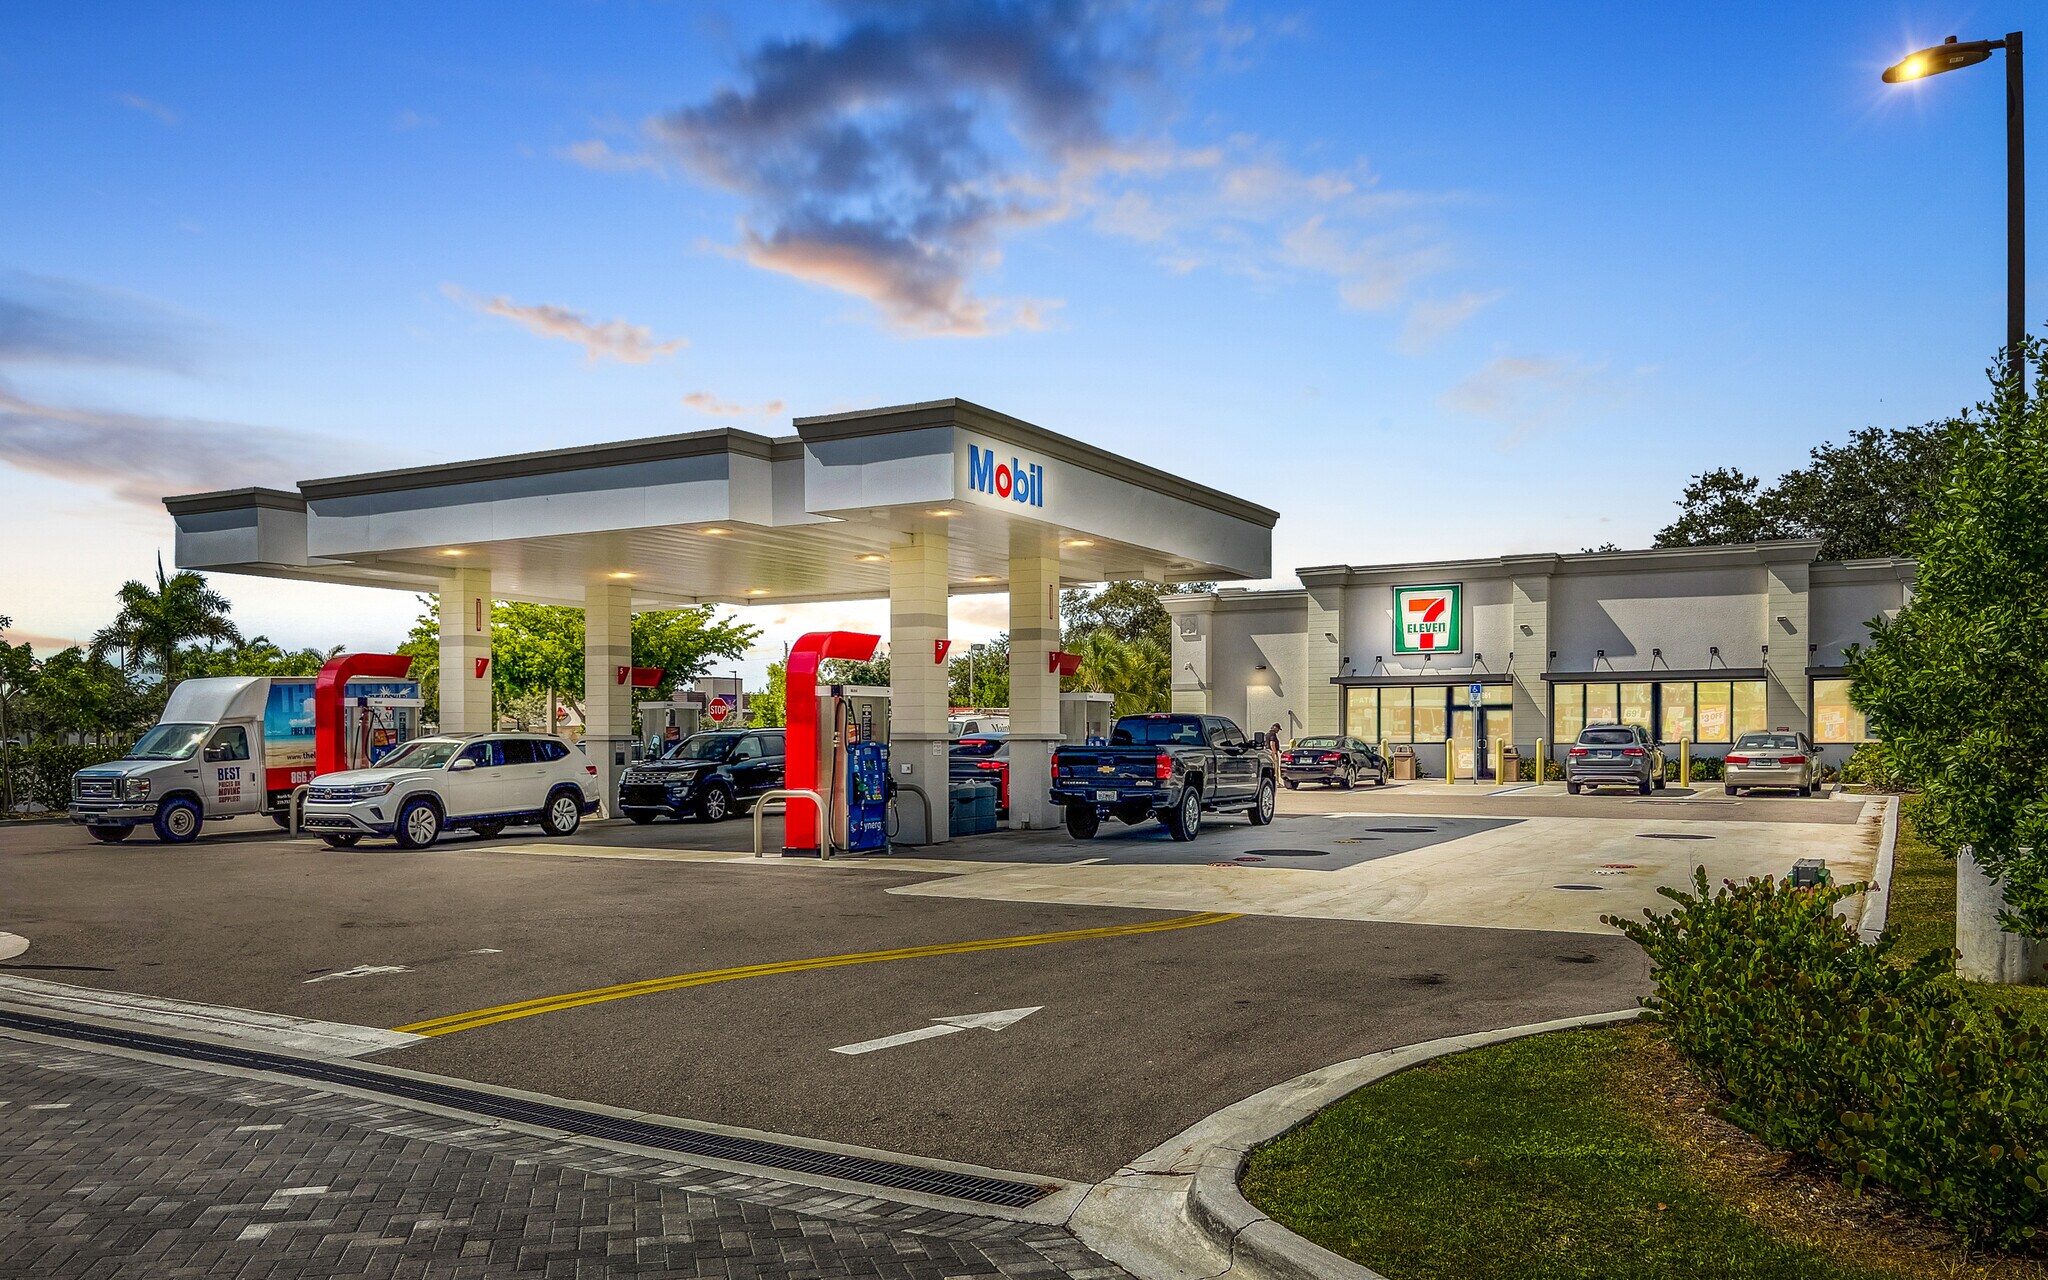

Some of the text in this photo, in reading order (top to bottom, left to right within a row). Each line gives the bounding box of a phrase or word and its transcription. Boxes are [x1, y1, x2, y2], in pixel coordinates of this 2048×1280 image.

[968, 443, 1043, 508] Mobil
[1408, 598, 1446, 649] 7
[938, 642, 943, 650] 3
[710, 705, 726, 715] STOP
[1710, 712, 1724, 720] OFF
[217, 767, 240, 780] BEST
[291, 770, 317, 784] 866.3
[218, 787, 240, 796] MOVING
